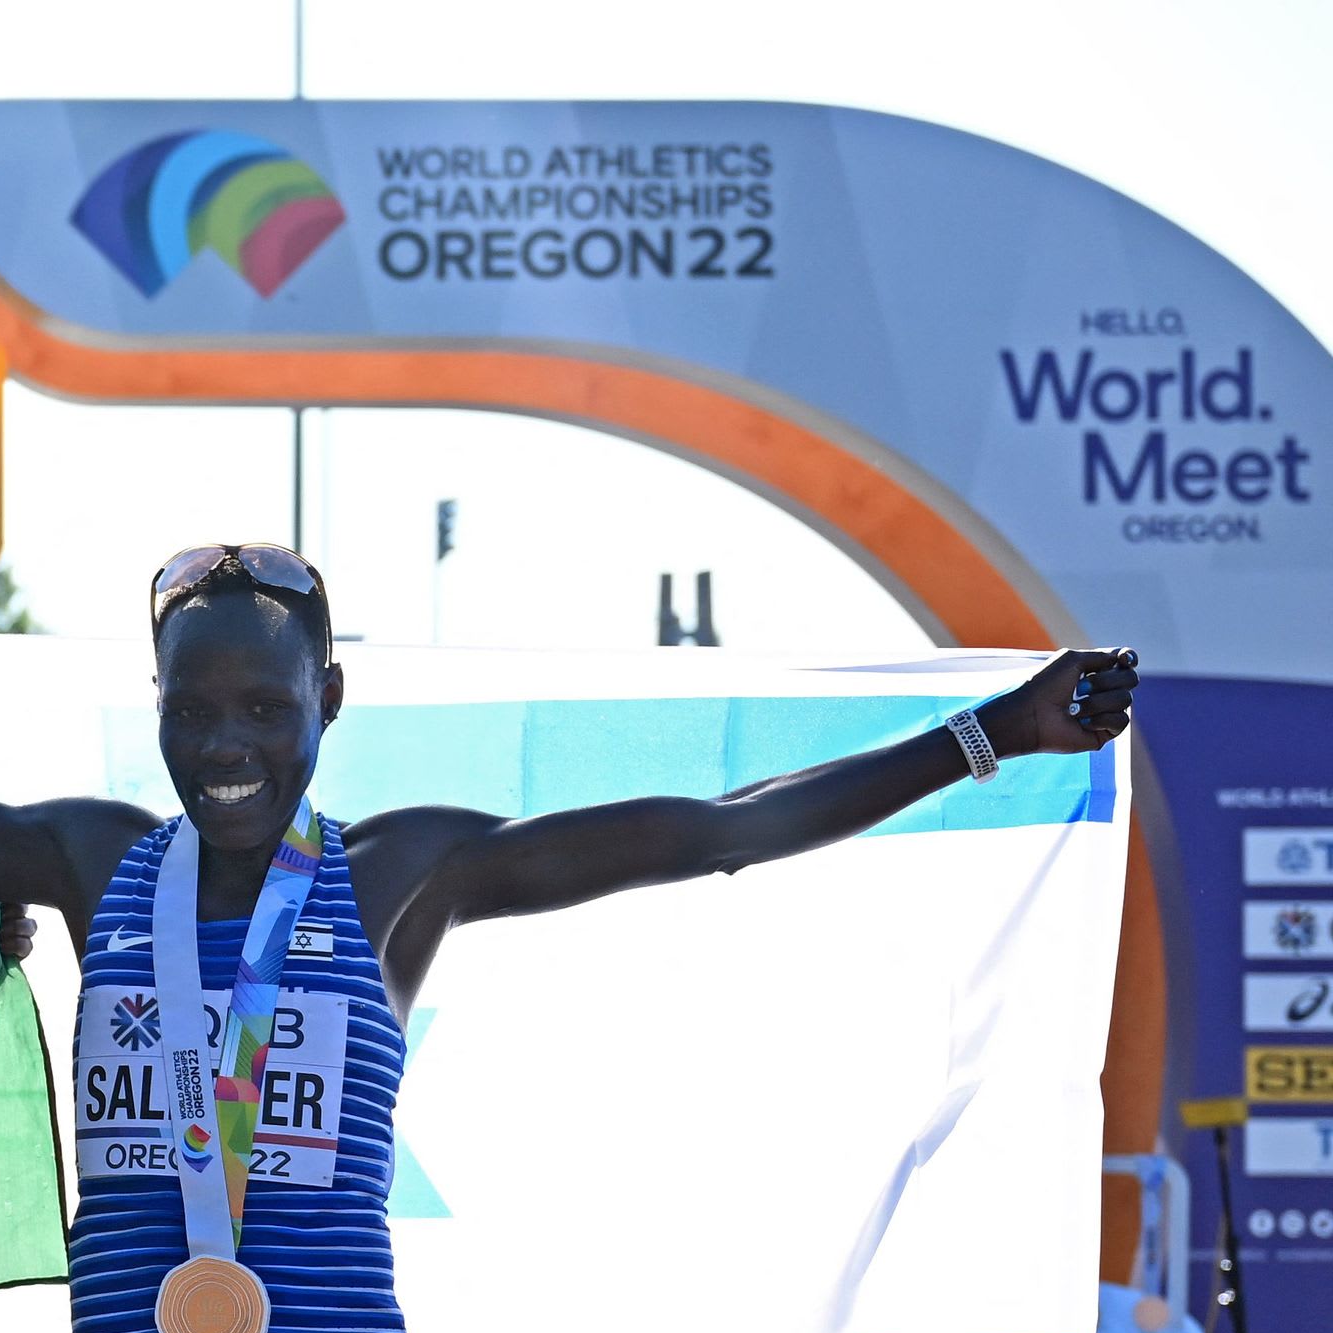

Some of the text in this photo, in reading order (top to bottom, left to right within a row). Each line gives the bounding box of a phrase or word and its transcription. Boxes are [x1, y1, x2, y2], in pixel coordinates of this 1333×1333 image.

[377, 145, 774, 180] WORLD ATHLETICS
[378, 185, 774, 221] CHAMPIONSHIPS
[1000, 348, 1273, 424] World.
[1083, 430, 1312, 505] Meet
[85, 1064, 325, 1130] SALER
[179, 1050, 194, 1119] CHAMPIONSHIPS
